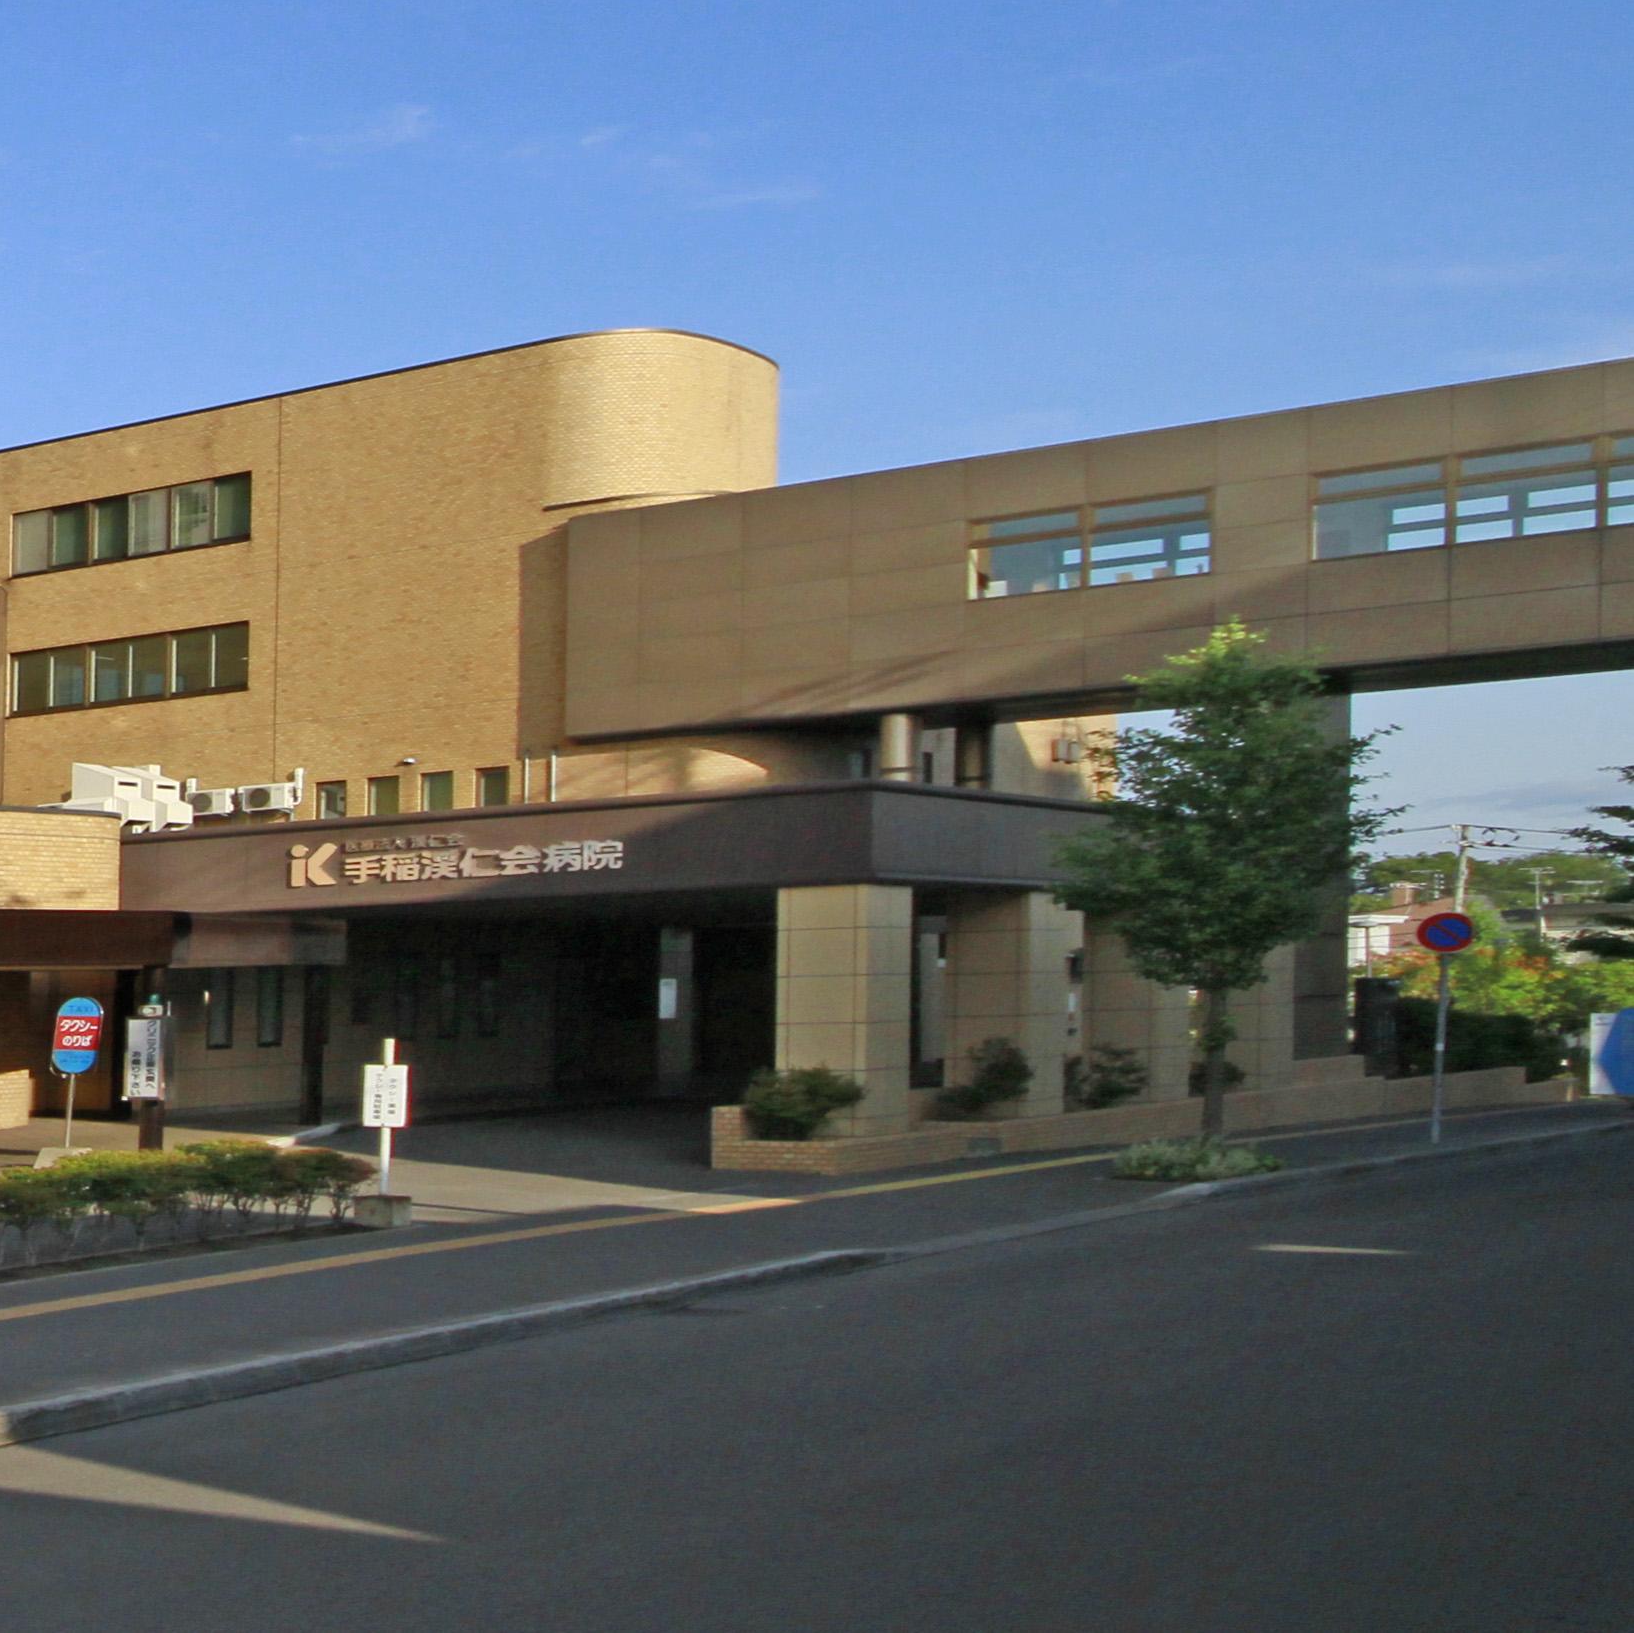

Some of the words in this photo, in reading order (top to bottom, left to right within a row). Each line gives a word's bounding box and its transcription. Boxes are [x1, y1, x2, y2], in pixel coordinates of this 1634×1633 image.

[344, 840, 624, 885] 手稲渓仁会病院
[60, 1019, 98, 1032] タクシー
[62, 1035, 93, 1047] のりば
